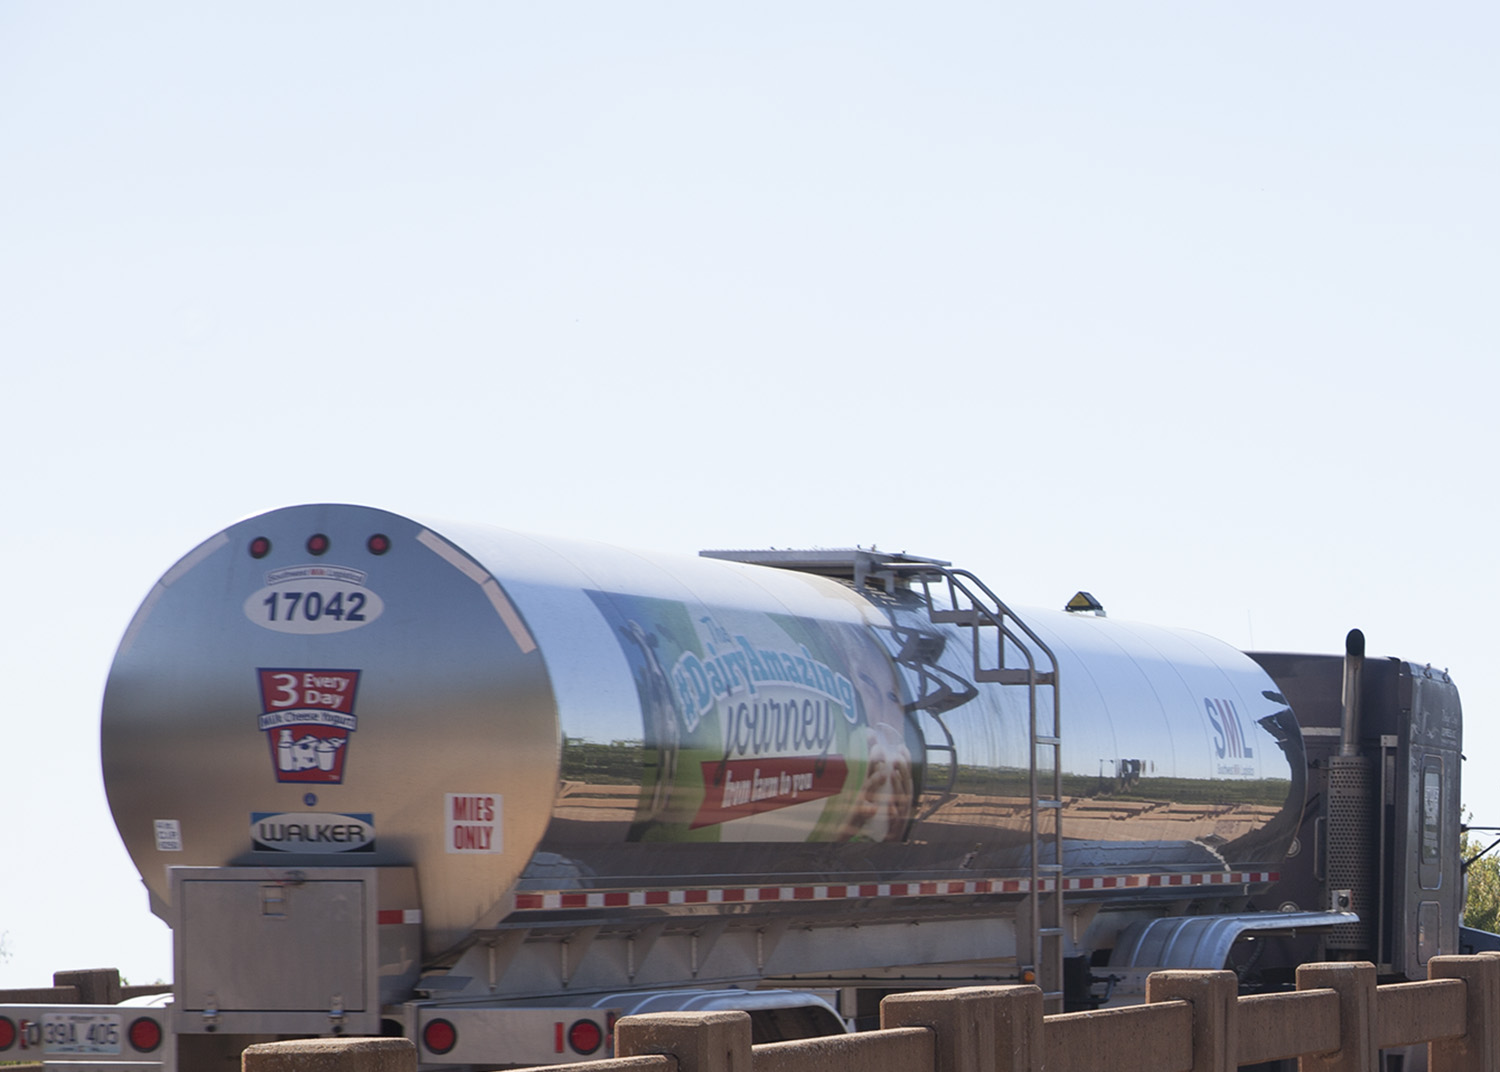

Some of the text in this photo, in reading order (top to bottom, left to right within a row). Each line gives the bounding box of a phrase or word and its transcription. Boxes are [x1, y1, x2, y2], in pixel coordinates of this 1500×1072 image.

[263, 591, 366, 621] 17042
[270, 673, 299, 708] 3
[303, 673, 350, 692] Every
[303, 690, 344, 709] Day
[1204, 697, 1253, 759] SML
[452, 797, 494, 822] MIES
[259, 823, 365, 843] WALKER
[454, 825, 493, 850] ONLY
